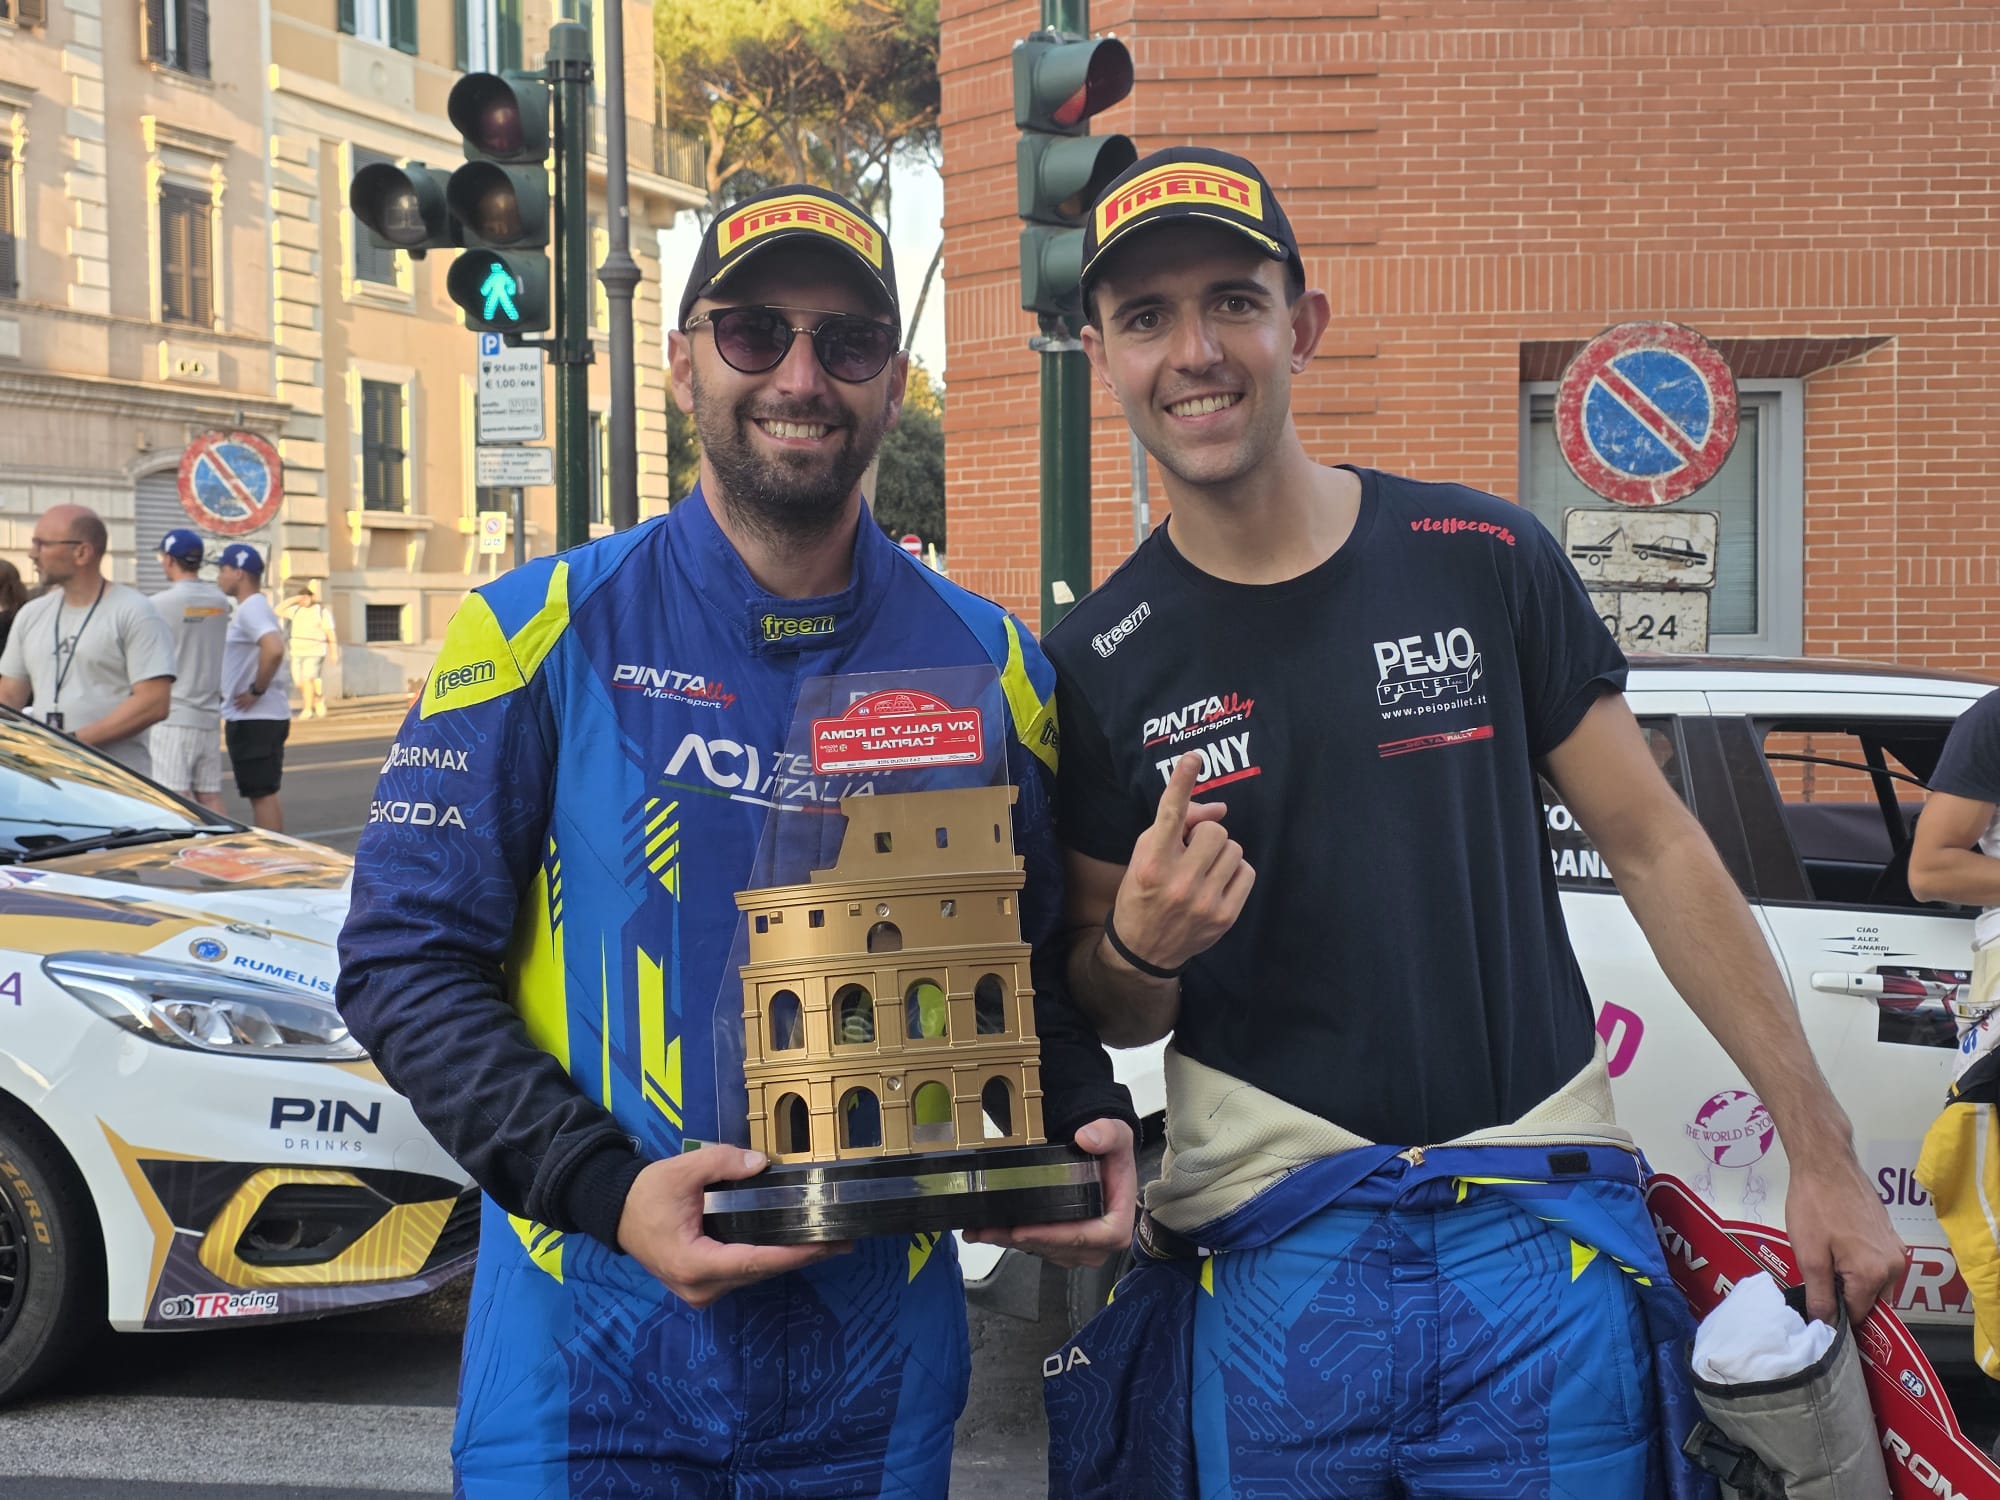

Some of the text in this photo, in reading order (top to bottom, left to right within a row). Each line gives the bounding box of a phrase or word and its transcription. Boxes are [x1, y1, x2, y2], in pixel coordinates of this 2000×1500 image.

[1105, 170, 1250, 229] PIRELLI
[729, 201, 873, 254] PIRELLI
[762, 614, 835, 640] freem
[1092, 602, 1151, 657] freem
[1373, 627, 1475, 680] PEJO
[643, 687, 722, 709] Motorsport
[1383, 677, 1452, 695] PALLET
[1381, 695, 1488, 720] www.pejopallet.it
[1169, 713, 1243, 745] Motorsport
[1155, 731, 1251, 788] TONY
[270, 1096, 382, 1134] PIN
[285, 1138, 362, 1152] DRINKS
[1702, 1127, 1743, 1142] WORLD
[1744, 1124, 1755, 1137] IS
